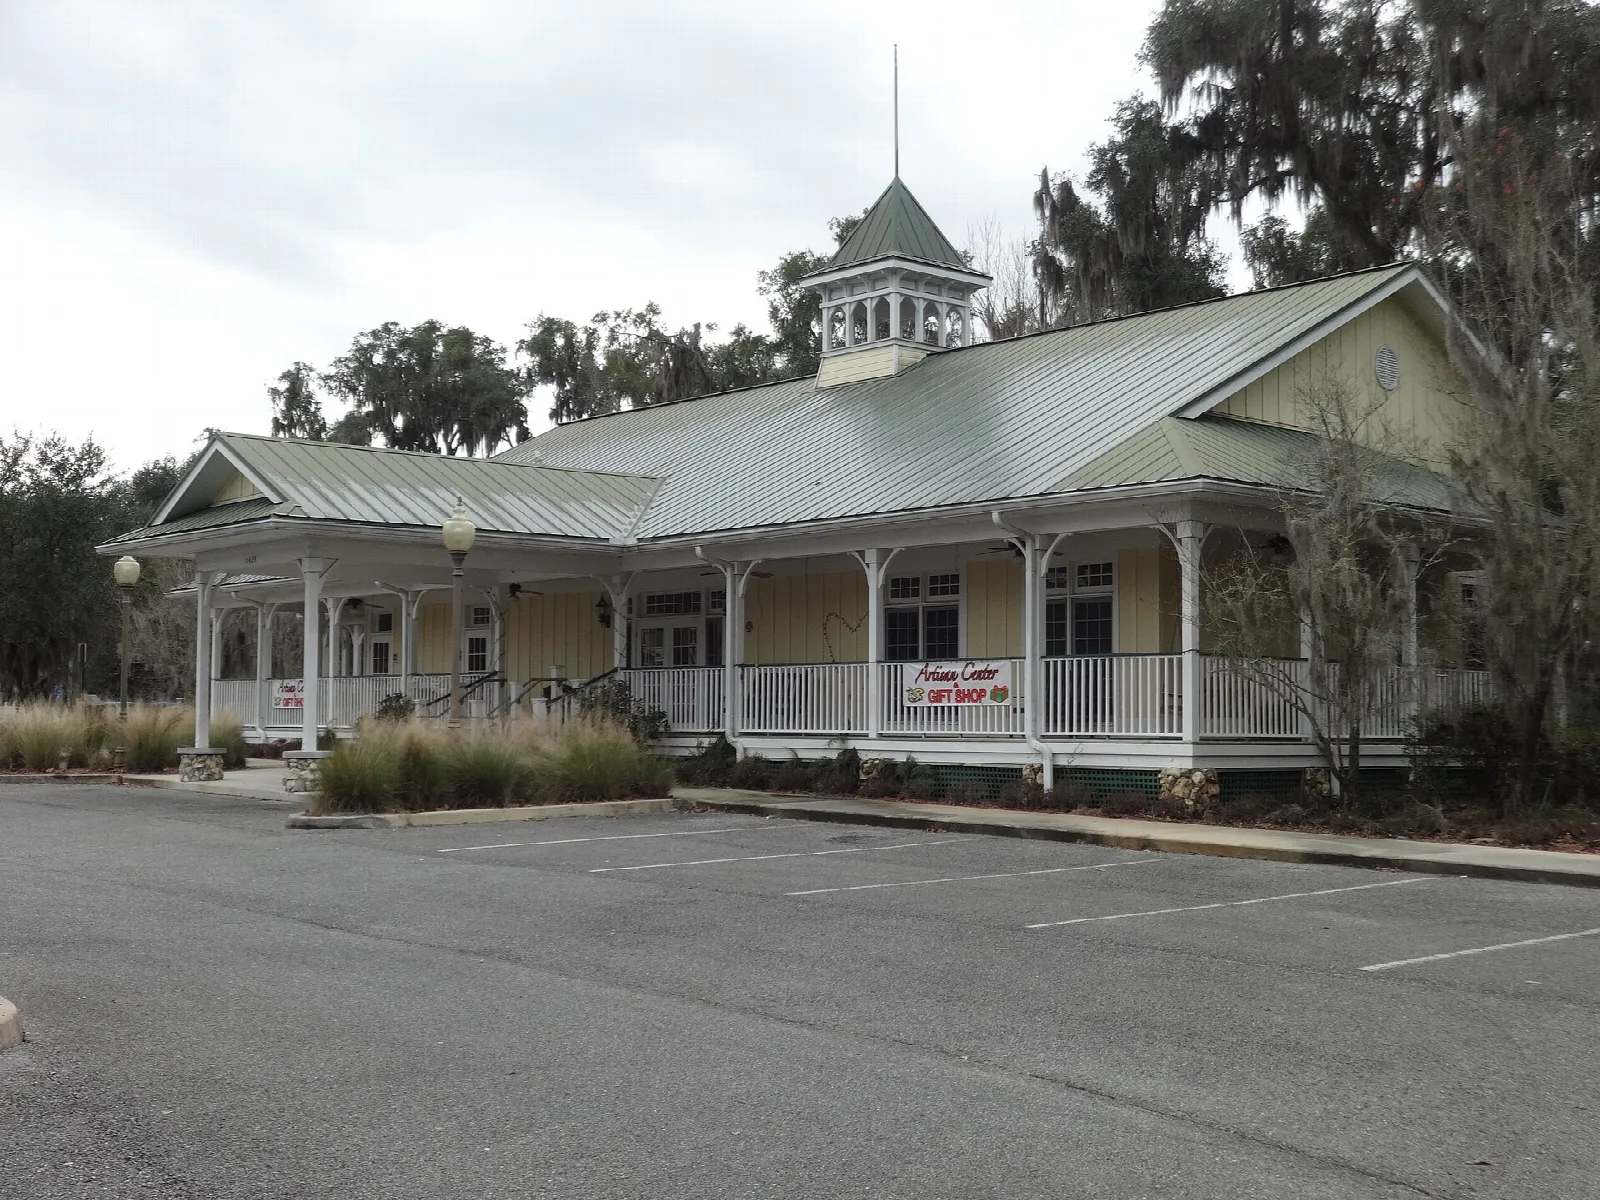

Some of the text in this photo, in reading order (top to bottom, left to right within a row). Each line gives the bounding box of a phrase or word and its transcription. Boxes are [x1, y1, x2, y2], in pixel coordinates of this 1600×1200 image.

[915, 661, 999, 684] Artisan Center
[927, 688, 987, 704] GIFT SHOP
